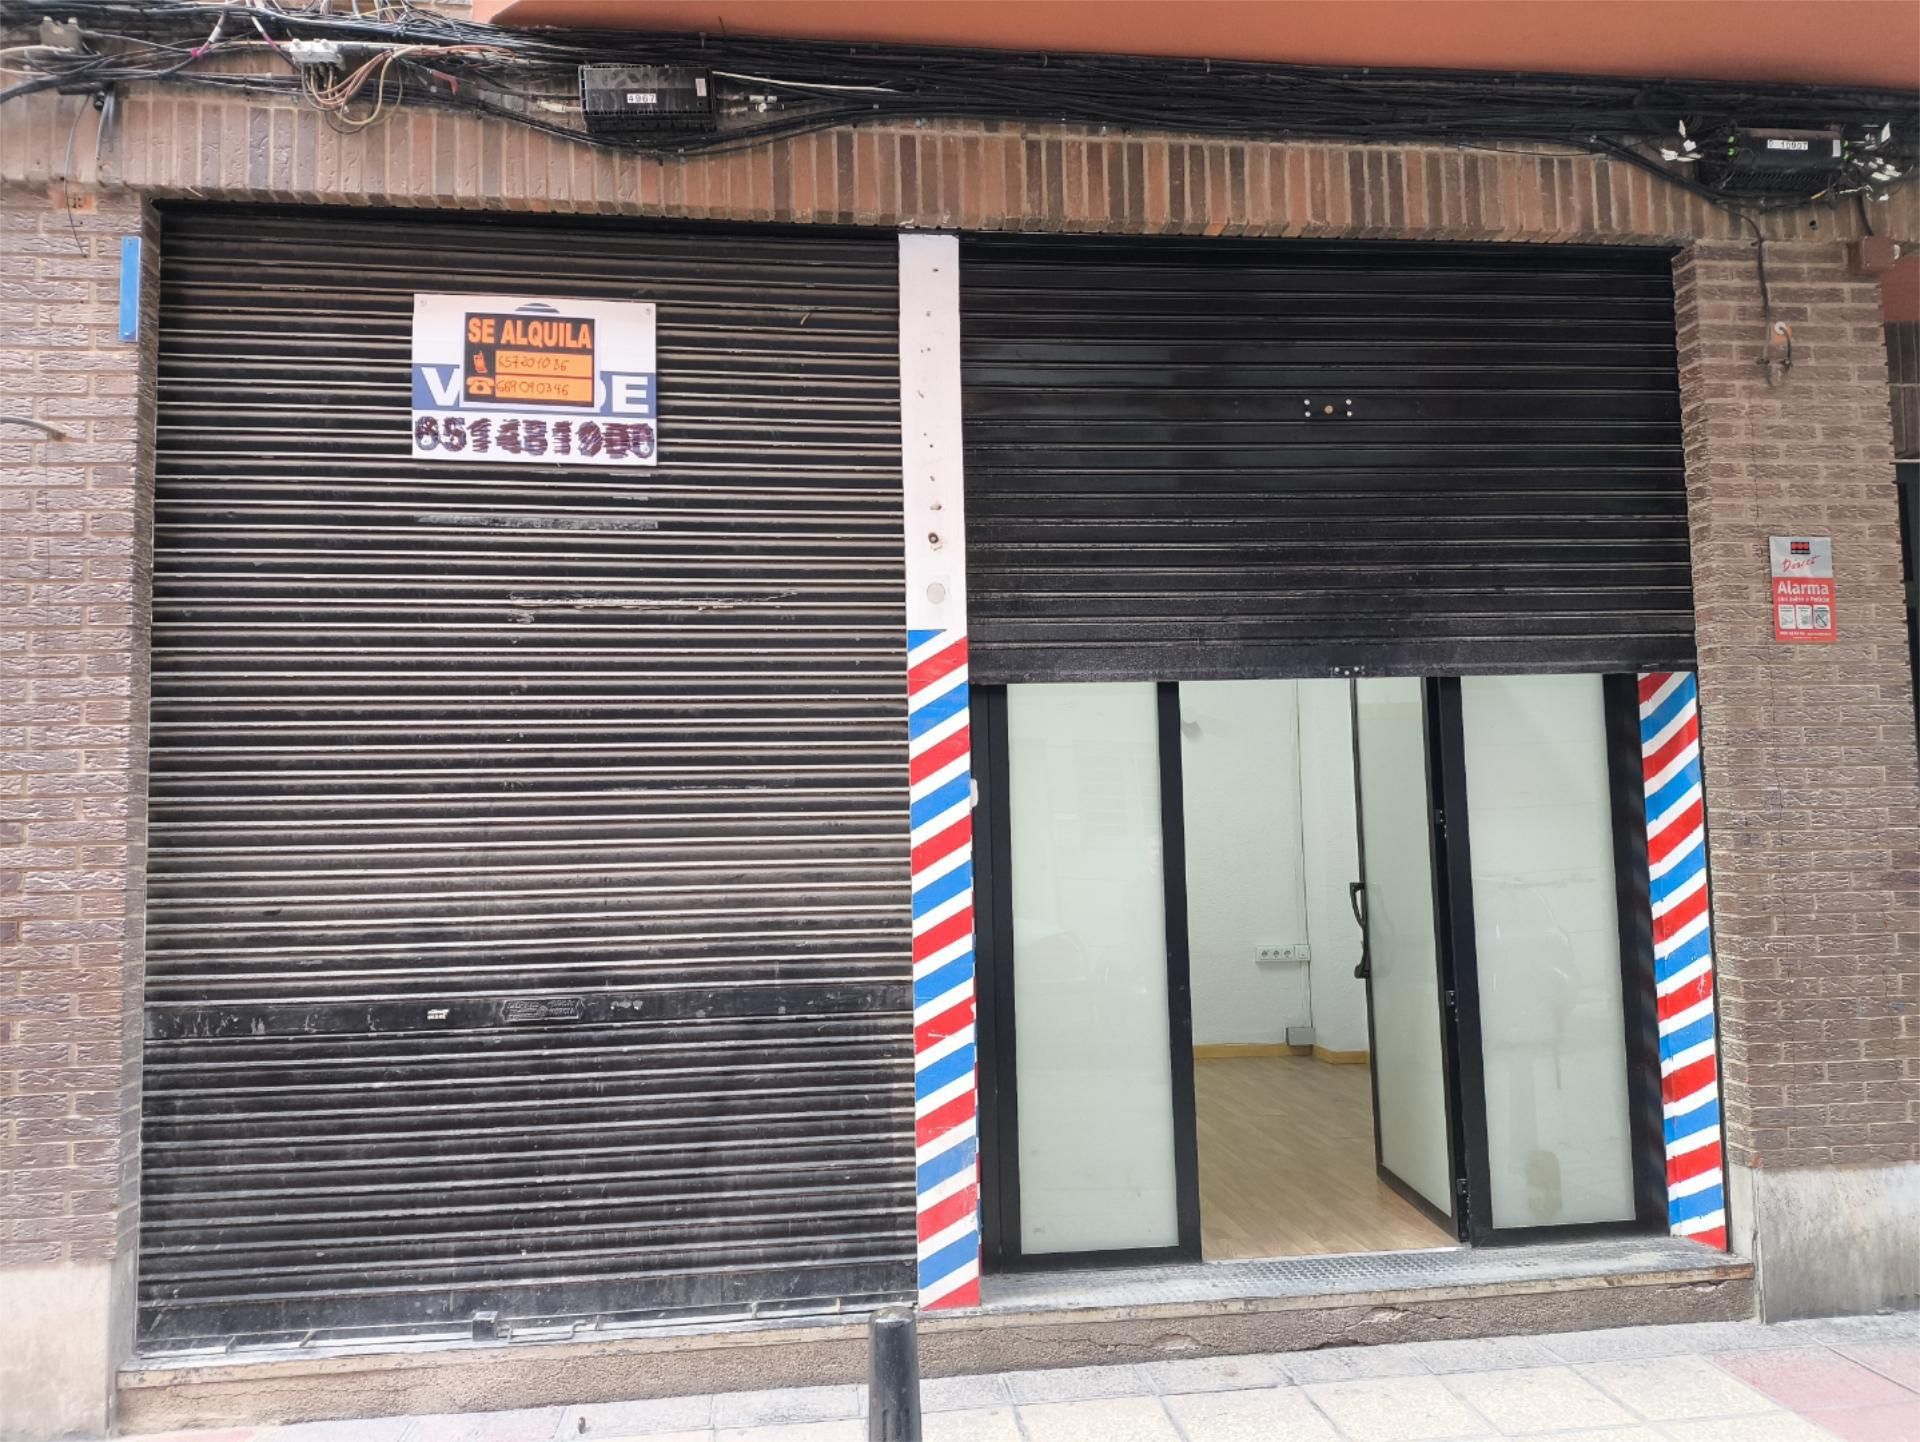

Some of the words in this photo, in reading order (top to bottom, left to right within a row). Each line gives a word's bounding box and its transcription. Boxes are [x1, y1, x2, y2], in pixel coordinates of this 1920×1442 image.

[468, 317, 495, 344] SE
[500, 319, 593, 349] ALQUILA
[1777, 580, 1829, 595] Alarma
